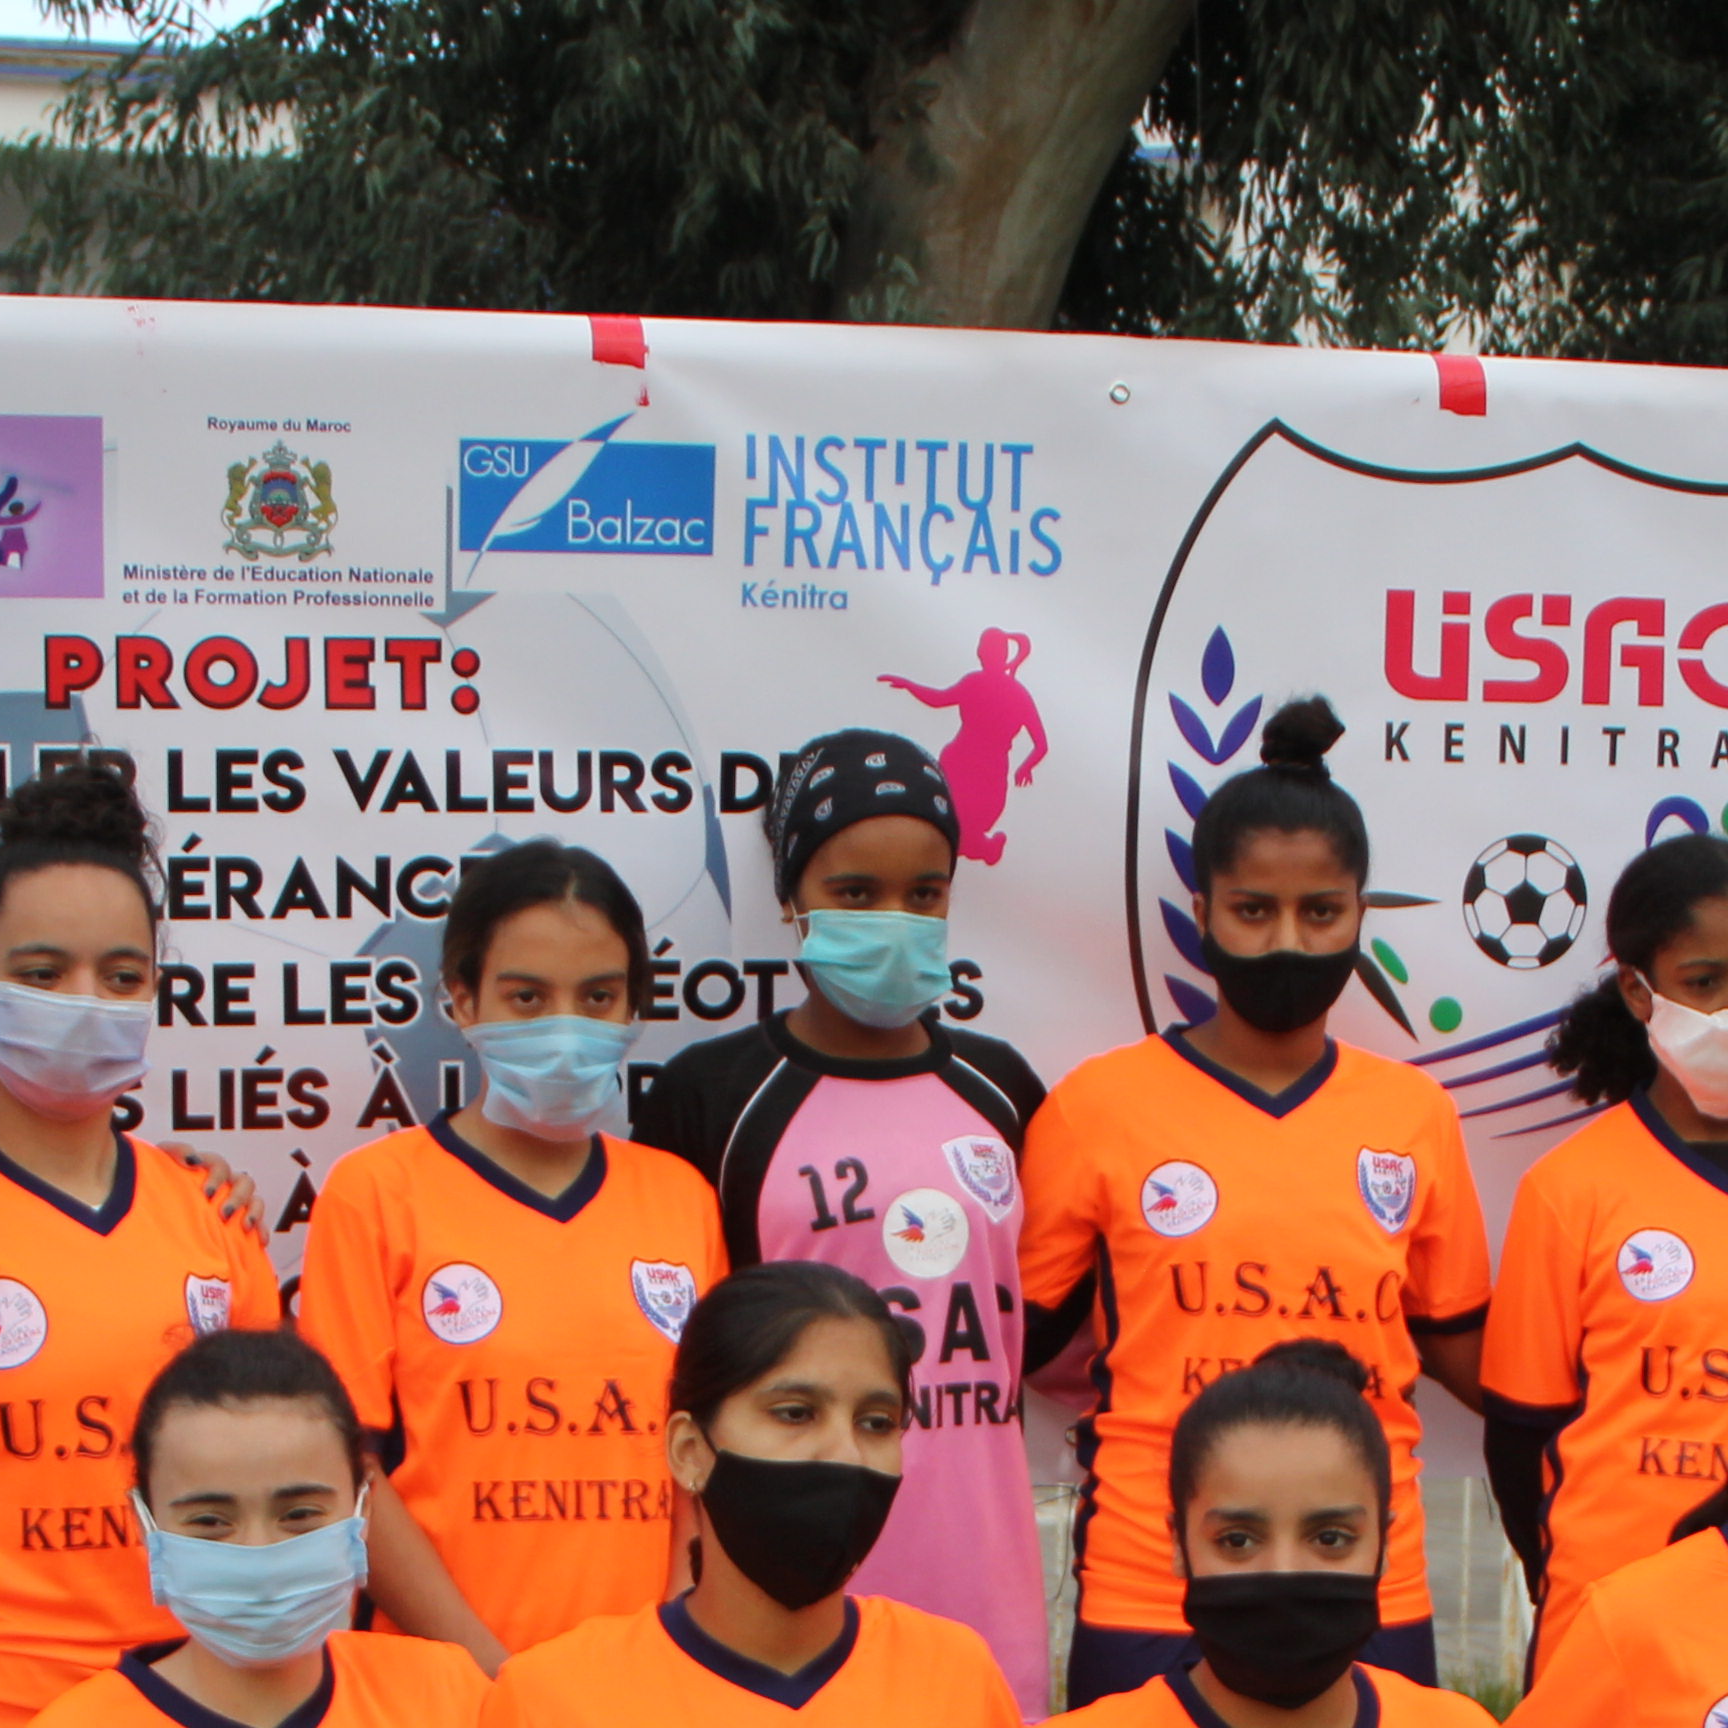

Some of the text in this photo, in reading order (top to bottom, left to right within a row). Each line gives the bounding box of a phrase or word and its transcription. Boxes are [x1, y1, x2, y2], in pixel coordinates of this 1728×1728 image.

[207, 416, 352, 433] Royaume du Maroc
[463, 446, 530, 478] GSU
[745, 433, 1034, 512] INSTITUT
[567, 499, 706, 548] Balzac
[743, 498, 1063, 586] FRANÇAIS
[122, 588, 435, 608] et de la Formation Professionnelle
[123, 563, 434, 584] Ministère de l'Education Nationale
[741, 580, 849, 611] Kénitra
[43, 634, 481, 715] PROJET:
[167, 748, 307, 814] LES
[332, 748, 693, 815] VALEURS
[156, 832, 508, 920] ÉRANC
[282, 960, 420, 1027] LES
[171, 1045, 330, 1131] LIÉS
[357, 1040, 420, 1128] À
[798, 1156, 876, 1232] 12
[1169, 1261, 1402, 1323] U.S.A.C
[457, 1376, 659, 1437] U.S.A.
